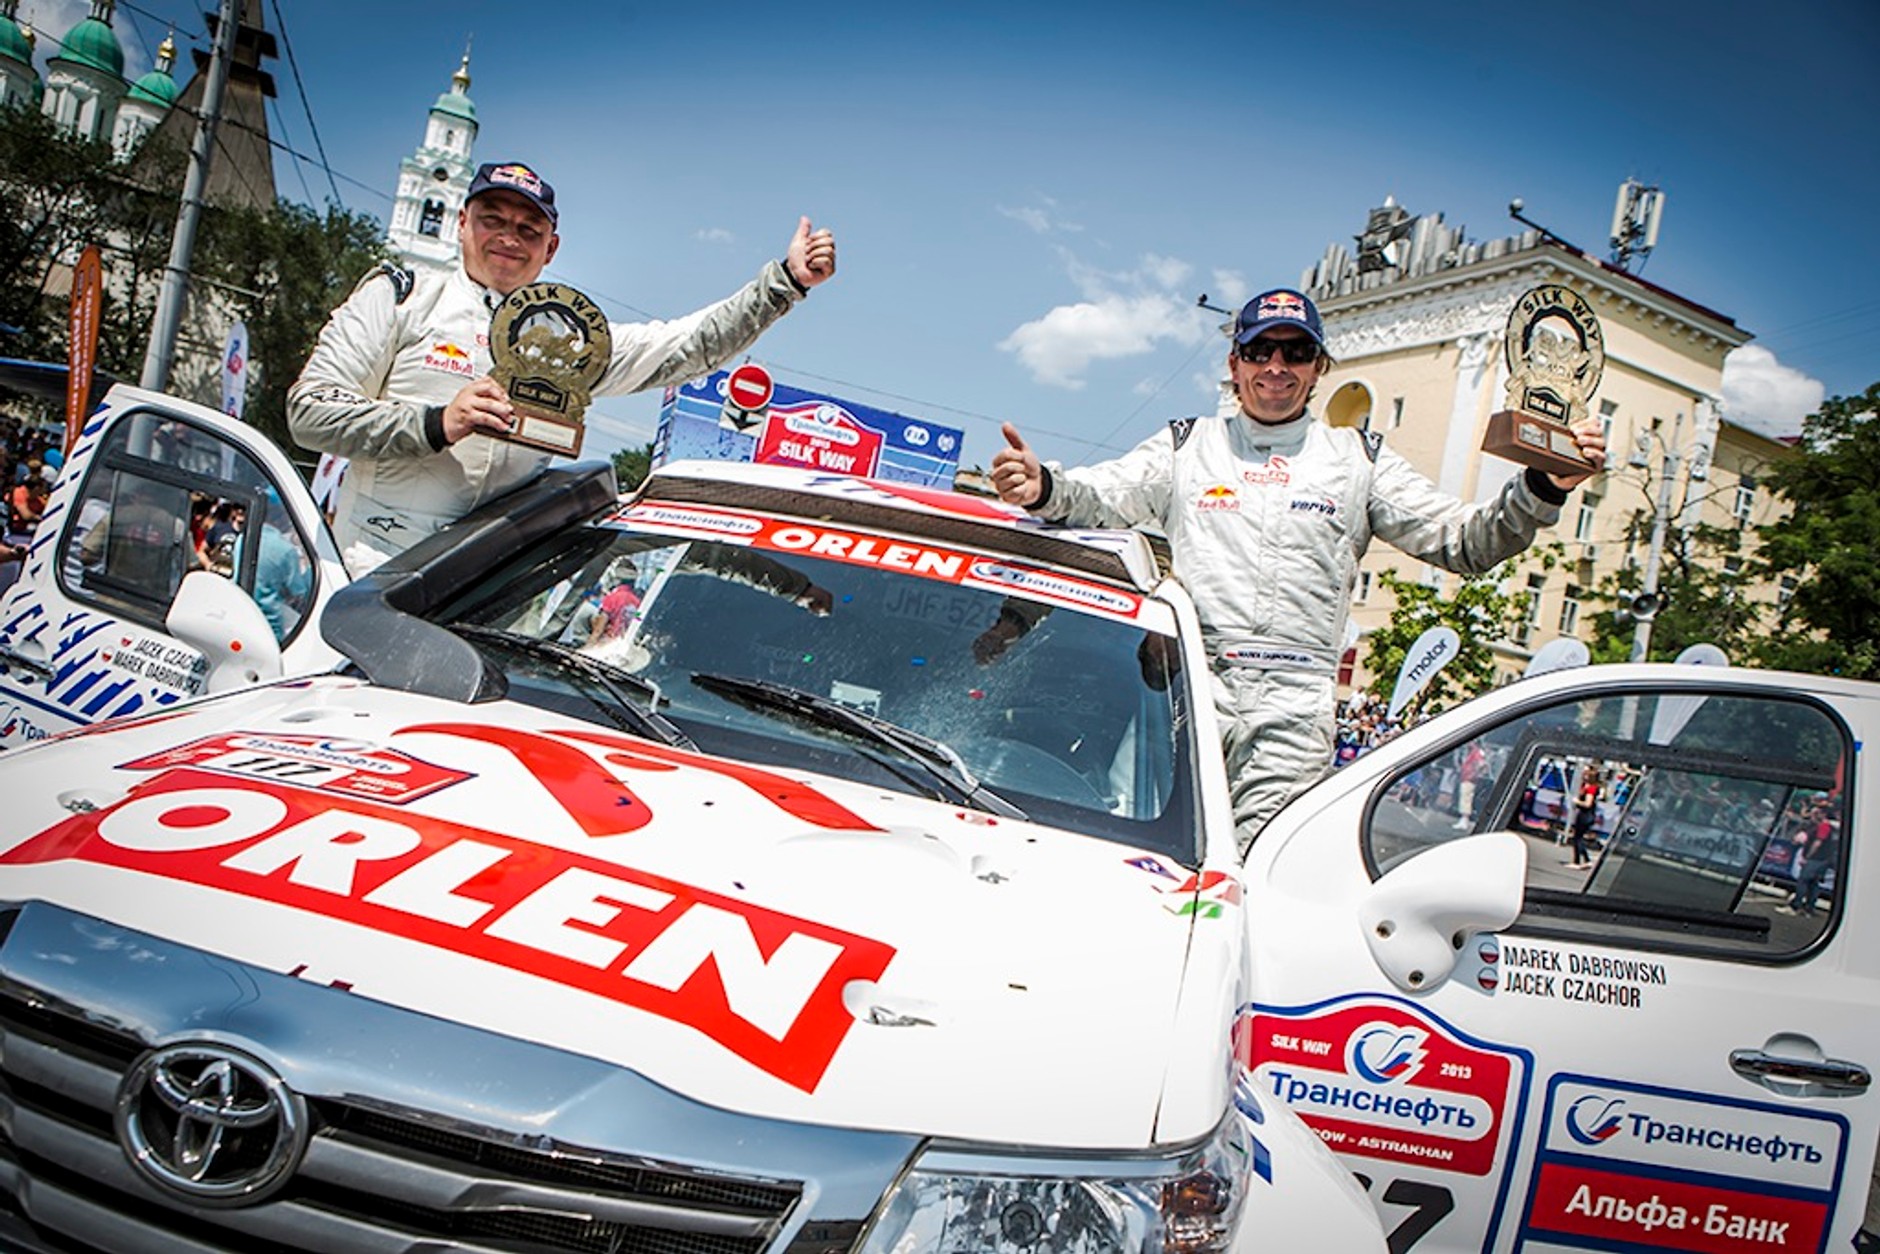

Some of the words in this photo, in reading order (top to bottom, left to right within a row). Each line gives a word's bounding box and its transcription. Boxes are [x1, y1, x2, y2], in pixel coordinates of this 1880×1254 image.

[511, 286, 560, 310] SILK
[571, 295, 605, 334] WAY
[1523, 289, 1563, 315] SILK
[1572, 299, 1598, 341] WAY
[425, 354, 449, 369] Red
[780, 440, 816, 463] SILK
[819, 449, 856, 472] WAY
[770, 527, 963, 577] ORLEN
[112, 650, 146, 673] MAREK
[134, 638, 166, 660] JACEK
[1406, 637, 1449, 684] motor
[228, 757, 332, 777] 117
[97, 788, 845, 1043] ORLEN
[1503, 945, 1562, 972] MAREK
[1568, 953, 1667, 985] DABROWSKI
[1504, 972, 1556, 997] JACEK
[1562, 978, 1641, 1008] CZACHOR
[1270, 1033, 1299, 1051] SILK
[1301, 1039, 1332, 1056] WAY
[1439, 1062, 1472, 1079] 2013
[1267, 1070, 1476, 1129] Транснефть
[1357, 1135, 1454, 1161] ASTRAKHAN
[1628, 1112, 1823, 1164] Транснефть
